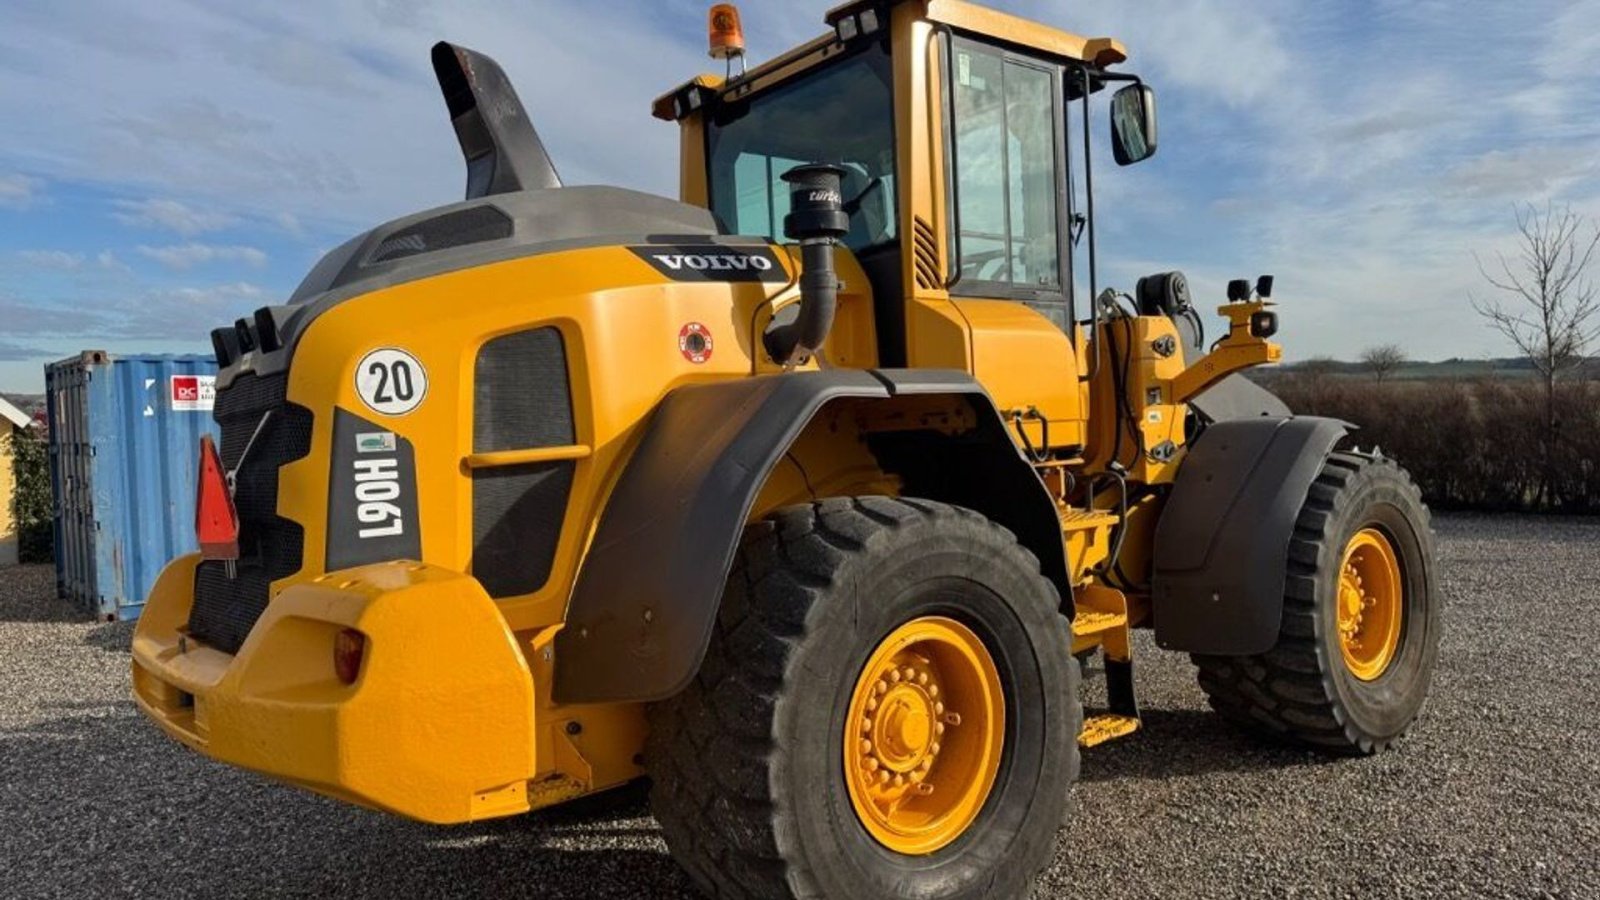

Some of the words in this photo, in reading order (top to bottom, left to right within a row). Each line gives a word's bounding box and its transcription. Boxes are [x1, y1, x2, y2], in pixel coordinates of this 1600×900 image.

[653, 255, 772, 270] VOLVO
[178, 387, 196, 396] DC
[369, 360, 414, 404] 20
[353, 458, 403, 539] L90H
